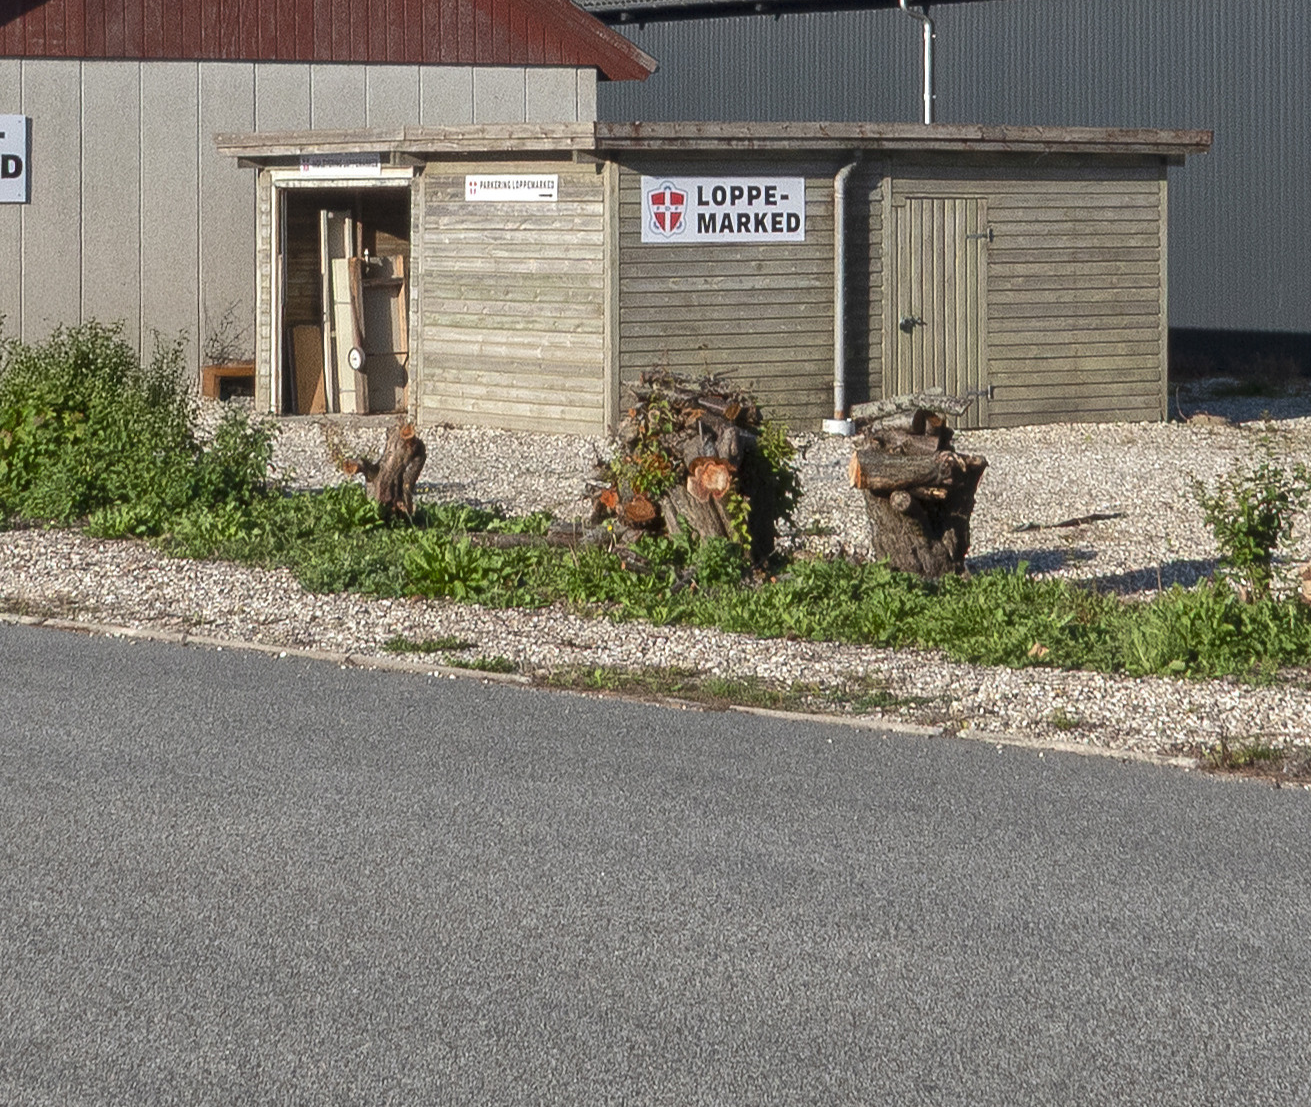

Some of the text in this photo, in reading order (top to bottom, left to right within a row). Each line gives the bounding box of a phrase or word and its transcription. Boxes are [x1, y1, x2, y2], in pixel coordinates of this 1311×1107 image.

[480, 180, 555, 190] PARKERING LOPPEMARKED
[697, 185, 789, 206] LOPPE-
[697, 212, 801, 234] MARKED
